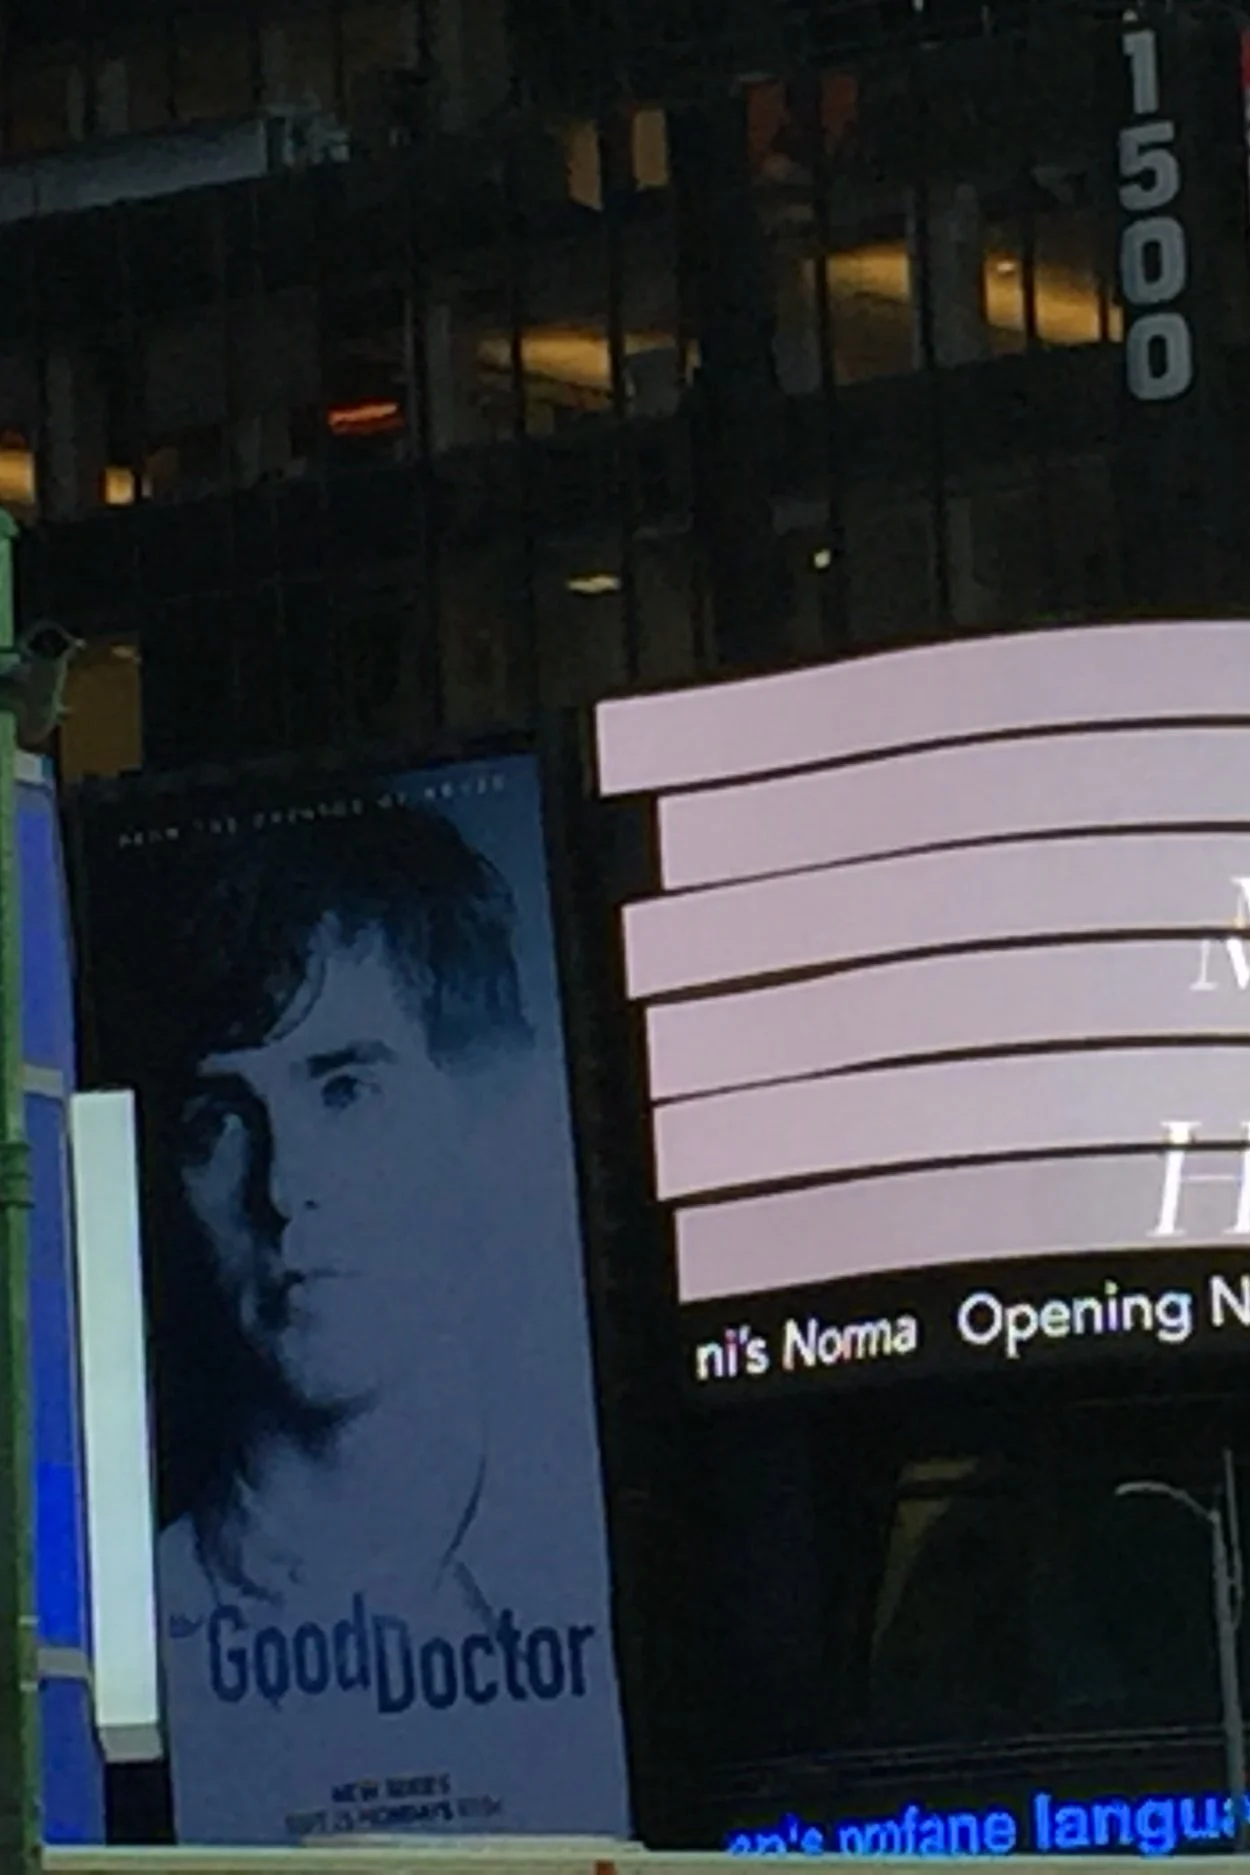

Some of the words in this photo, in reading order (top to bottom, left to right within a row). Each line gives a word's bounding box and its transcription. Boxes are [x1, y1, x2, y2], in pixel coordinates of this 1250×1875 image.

[1117, 29, 1193, 401] 1500
[695, 1323, 769, 1382] ni's
[782, 1313, 918, 1371] Norma
[957, 1280, 1193, 1358] Opening
[207, 1591, 370, 1703] Good
[371, 1608, 597, 1714] Doctor
